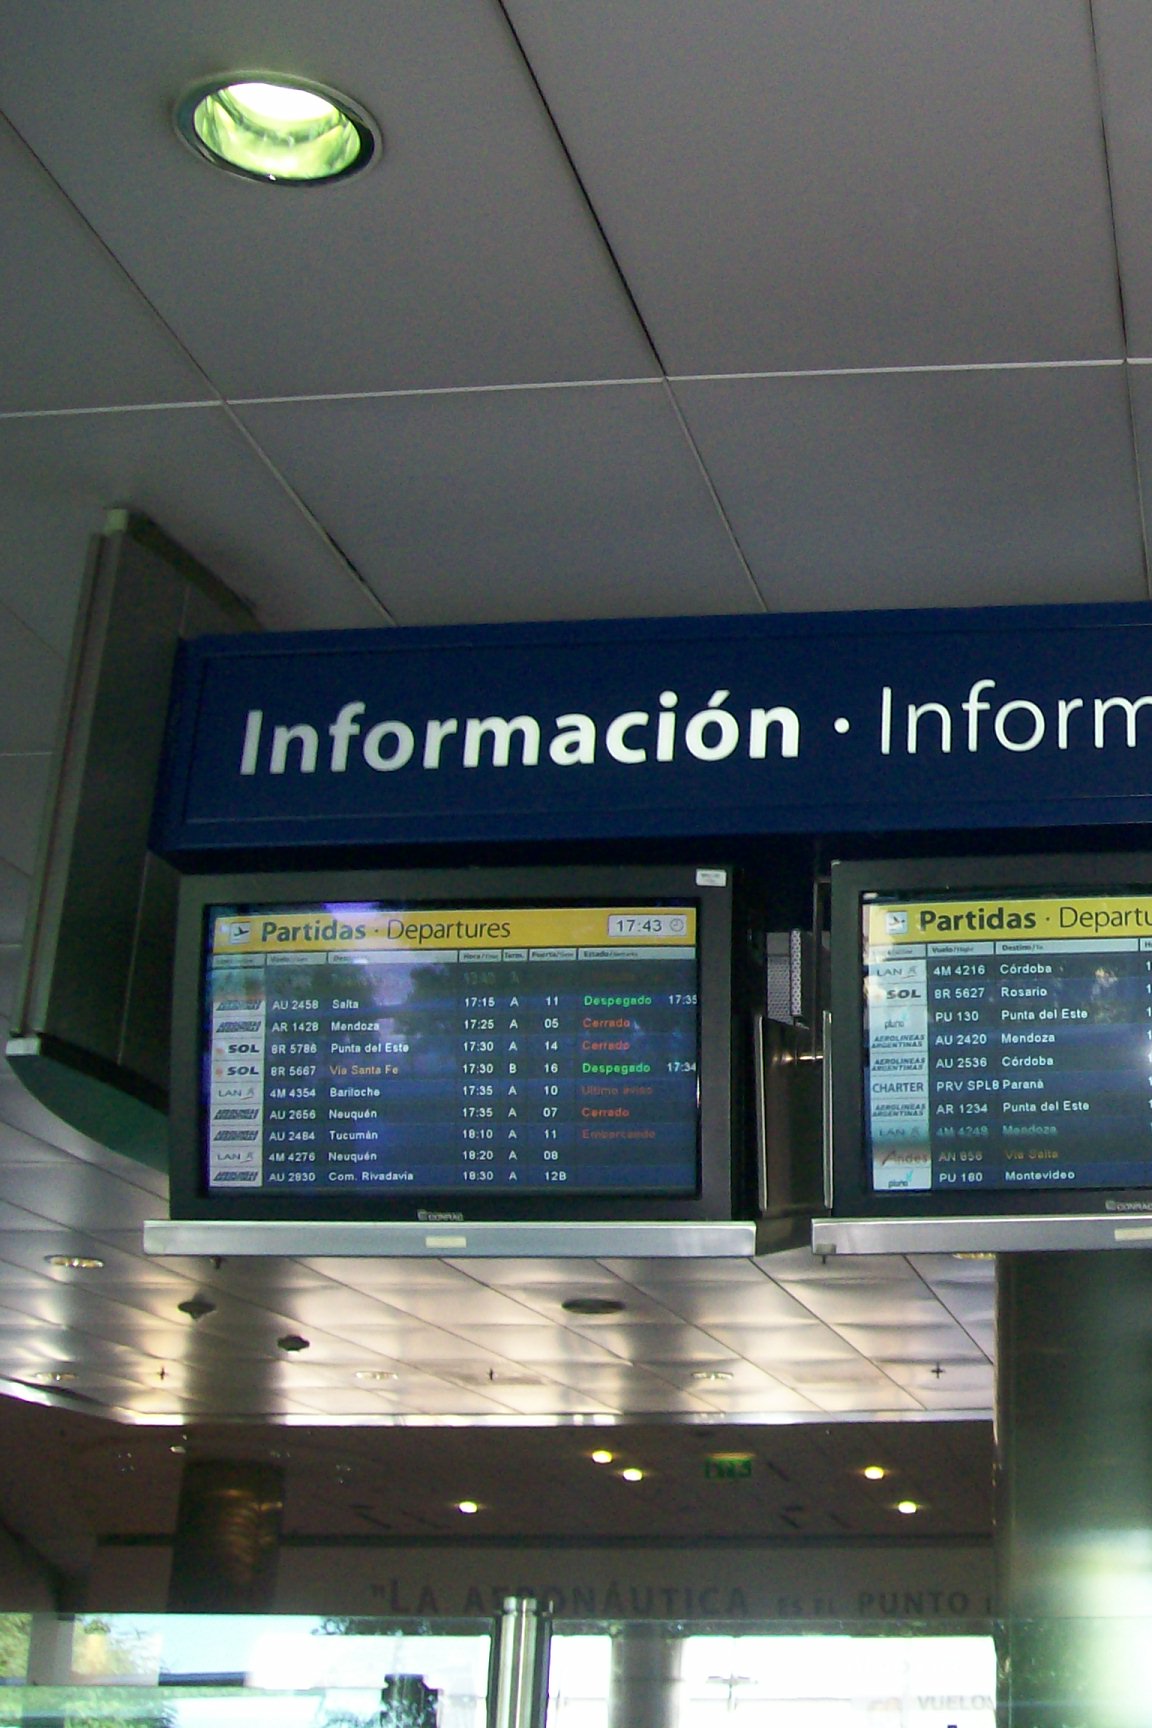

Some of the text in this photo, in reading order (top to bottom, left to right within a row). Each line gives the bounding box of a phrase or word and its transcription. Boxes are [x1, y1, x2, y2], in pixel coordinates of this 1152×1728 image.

[239, 690, 800, 776] Información
[919, 907, 1037, 931] Partidas
[261, 919, 663, 944] Partidas Departures 17:43
[932, 965, 952, 977] 4M
[954, 964, 986, 976] 4216
[999, 963, 1053, 975] Córdoba
[885, 988, 922, 1000] SOL
[954, 987, 985, 999] 5627
[1000, 986, 1049, 998] Rosario
[271, 1000, 288, 1010] AU
[291, 999, 320, 1010] 2458
[331, 999, 360, 1010] Salta
[463, 997, 496, 1008] 17:15
[545, 996, 559, 1007] 11
[583, 995, 653, 1009] Despegado
[668, 994, 699, 1006] 17:35
[934, 1011, 953, 1023] PU
[956, 1010, 980, 1022] 130
[1000, 1009, 1036, 1021] Punta
[1038, 1009, 1058, 1021] del
[1061, 1008, 1089, 1020] Este
[271, 1021, 288, 1032] AR
[292, 1021, 320, 1032] 1428
[330, 1020, 380, 1032] Mendoza
[463, 1019, 496, 1030] 17:25
[543, 1018, 560, 1029] 05
[582, 1017, 631, 1029] Cerrado
[934, 1034, 954, 1046] AU
[955, 1033, 988, 1045] 2420
[1000, 1032, 1056, 1045] Mendoza
[227, 1043, 261, 1054] SOL
[330, 1040, 631, 1054] Punta del Este 17:30 14 Cerrado
[350, 1061, 697, 1076] Santa Fe 17:30 16 Despegado 17:34
[934, 1057, 954, 1069] AU
[956, 1057, 988, 1069] 2536
[1001, 1055, 1055, 1067] Córdoba
[226, 1065, 260, 1077] SOL
[218, 1088, 242, 1098] LAN
[269, 1085, 559, 1098] 4M 4354 Bariloche 17:35 10
[871, 1082, 925, 1094] CHARTER
[936, 1081, 964, 1093] PRV
[268, 1110, 286, 1120] AU
[328, 1108, 378, 1122] Neuquén
[461, 1107, 494, 1118] 17:35
[542, 1107, 558, 1118] 07
[580, 1107, 631, 1118] Cerrado
[935, 1104, 954, 1115] AR
[958, 1102, 989, 1114] 1234
[1002, 1101, 1038, 1114] Punta
[1040, 1101, 1060, 1113] del
[1062, 1100, 1091, 1111] Este
[268, 1131, 286, 1142] AU
[328, 1130, 379, 1141] Tucumán
[461, 1128, 494, 1140] 18:10
[216, 1152, 241, 1161] LAN
[268, 1150, 559, 1164] 4M 4276 Neuquén 18:20 08
[268, 1172, 286, 1182] AU
[328, 1172, 358, 1182] Com.
[361, 1171, 415, 1182] Rivadavia
[462, 1170, 495, 1182] 18:30
[543, 1170, 567, 1182] 12B
[938, 1172, 957, 1183] PU
[1004, 1170, 1076, 1182] Montevideo
[859, 1590, 968, 1615] PUNTO
